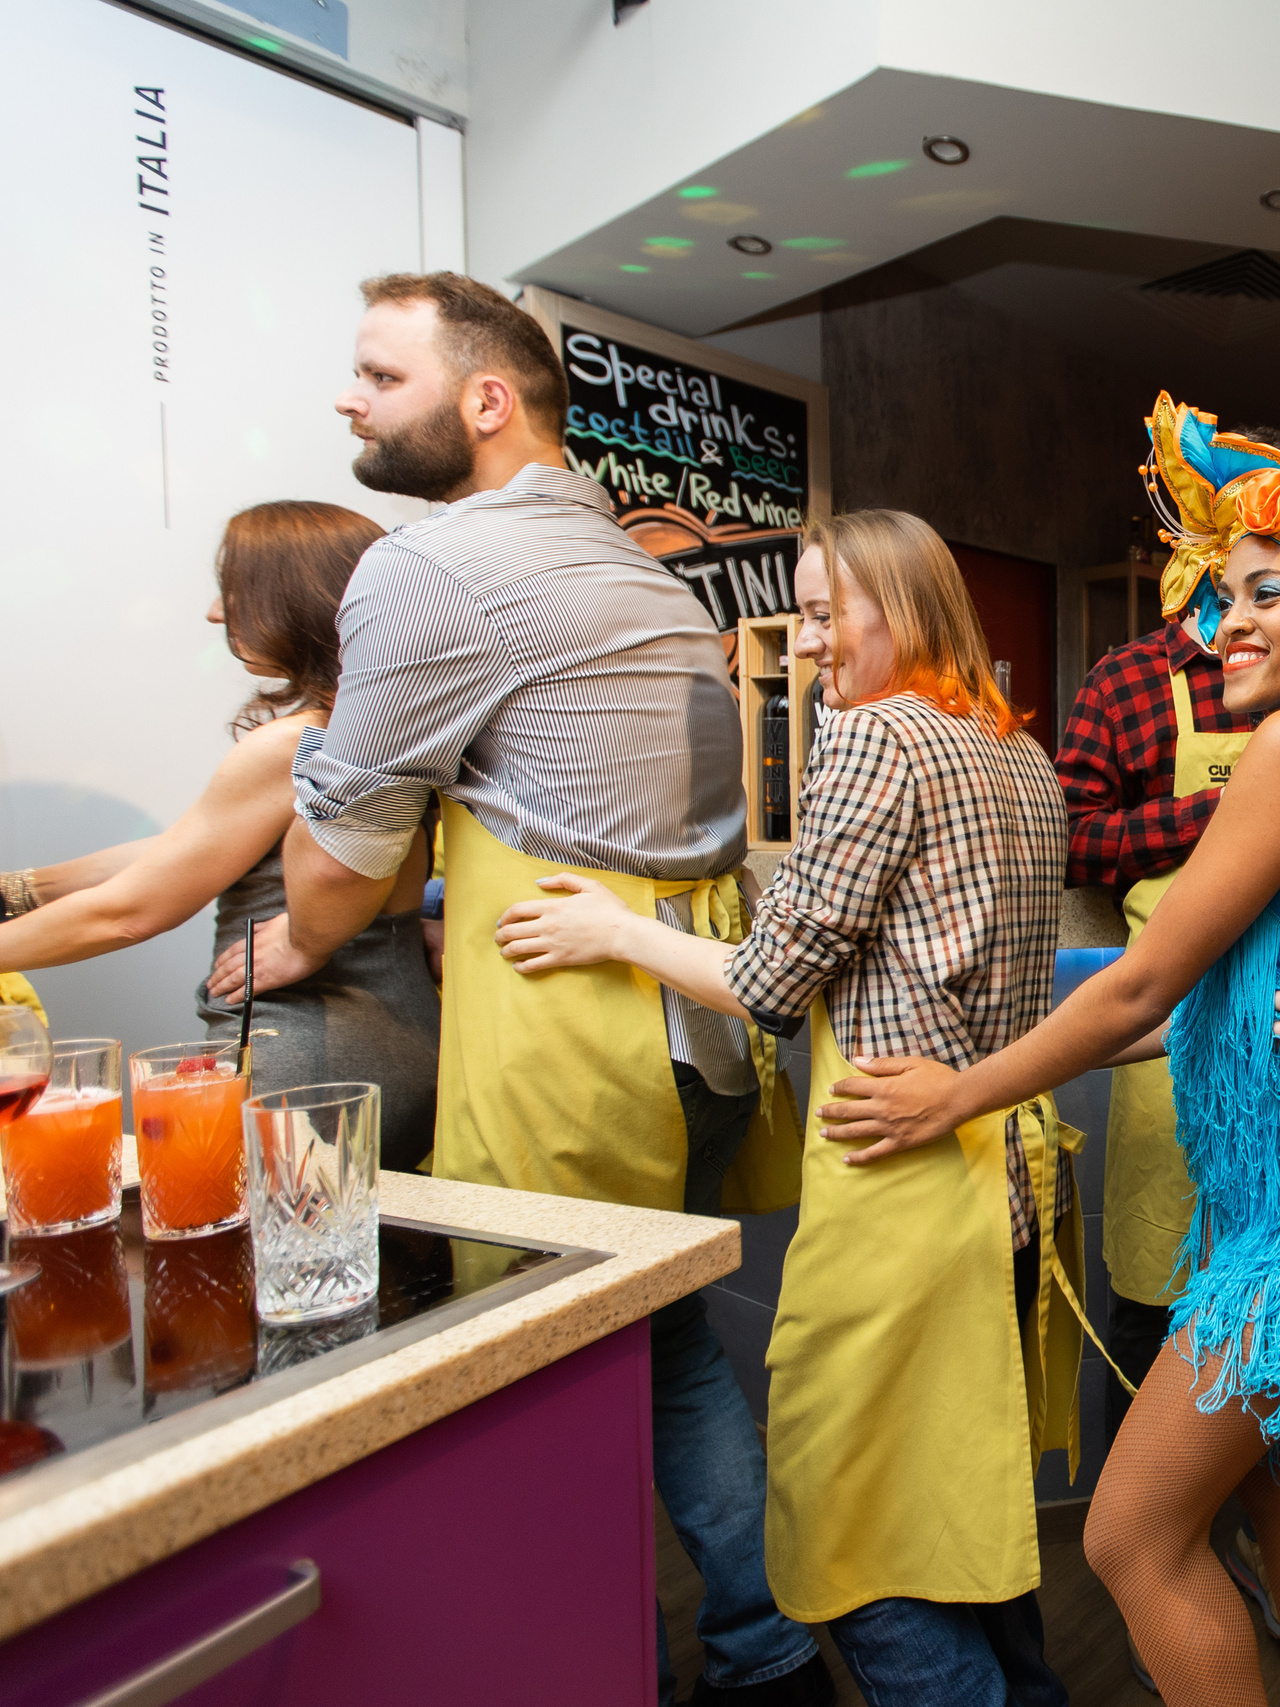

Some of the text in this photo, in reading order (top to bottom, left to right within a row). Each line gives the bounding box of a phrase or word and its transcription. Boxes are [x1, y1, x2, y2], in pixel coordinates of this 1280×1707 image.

[133, 85, 170, 384] PRODOTTO IN ITALIA
[566, 333, 723, 411] Special
[566, 404, 801, 484] coctail & Beer
[674, 551, 792, 631] TINI
